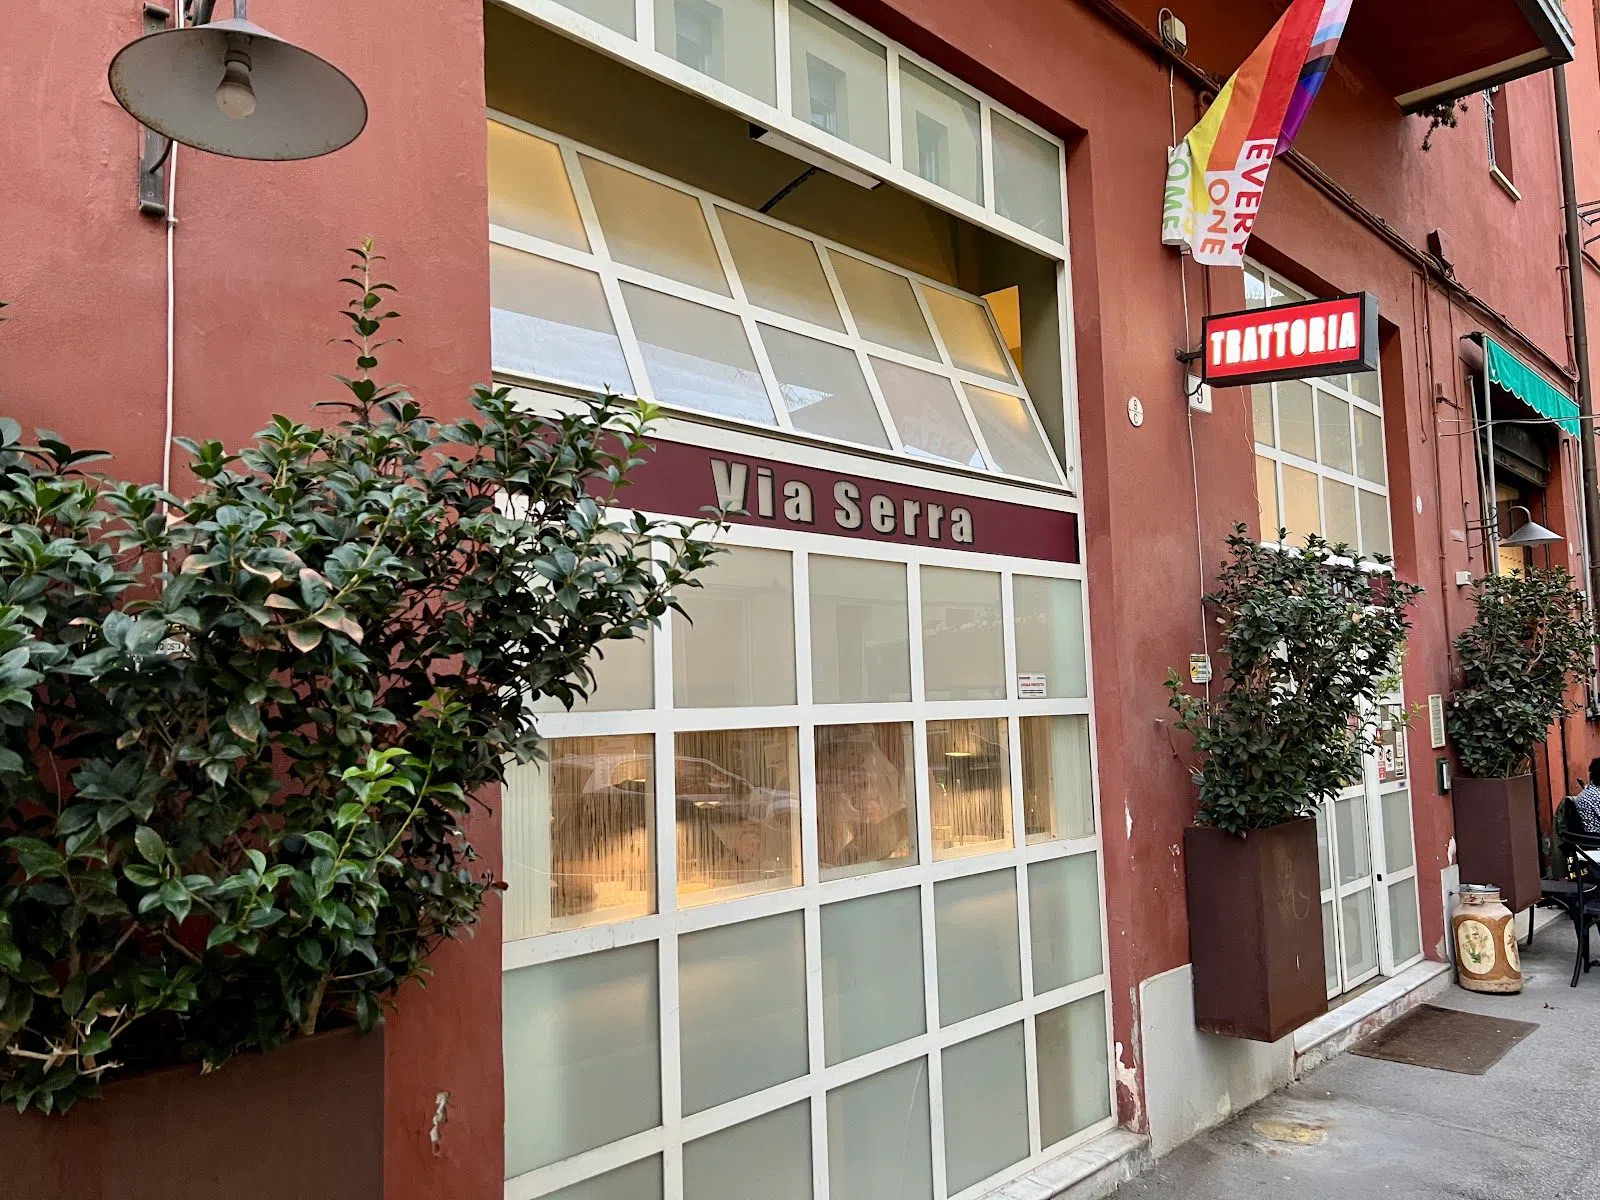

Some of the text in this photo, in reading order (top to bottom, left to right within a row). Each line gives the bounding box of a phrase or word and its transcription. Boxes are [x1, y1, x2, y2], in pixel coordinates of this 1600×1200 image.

[1199, 178, 1231, 256] ONE
[1232, 143, 1275, 256] EVERY
[1210, 311, 1357, 367] TRATTORIA
[710, 458, 974, 544] Via Serra
